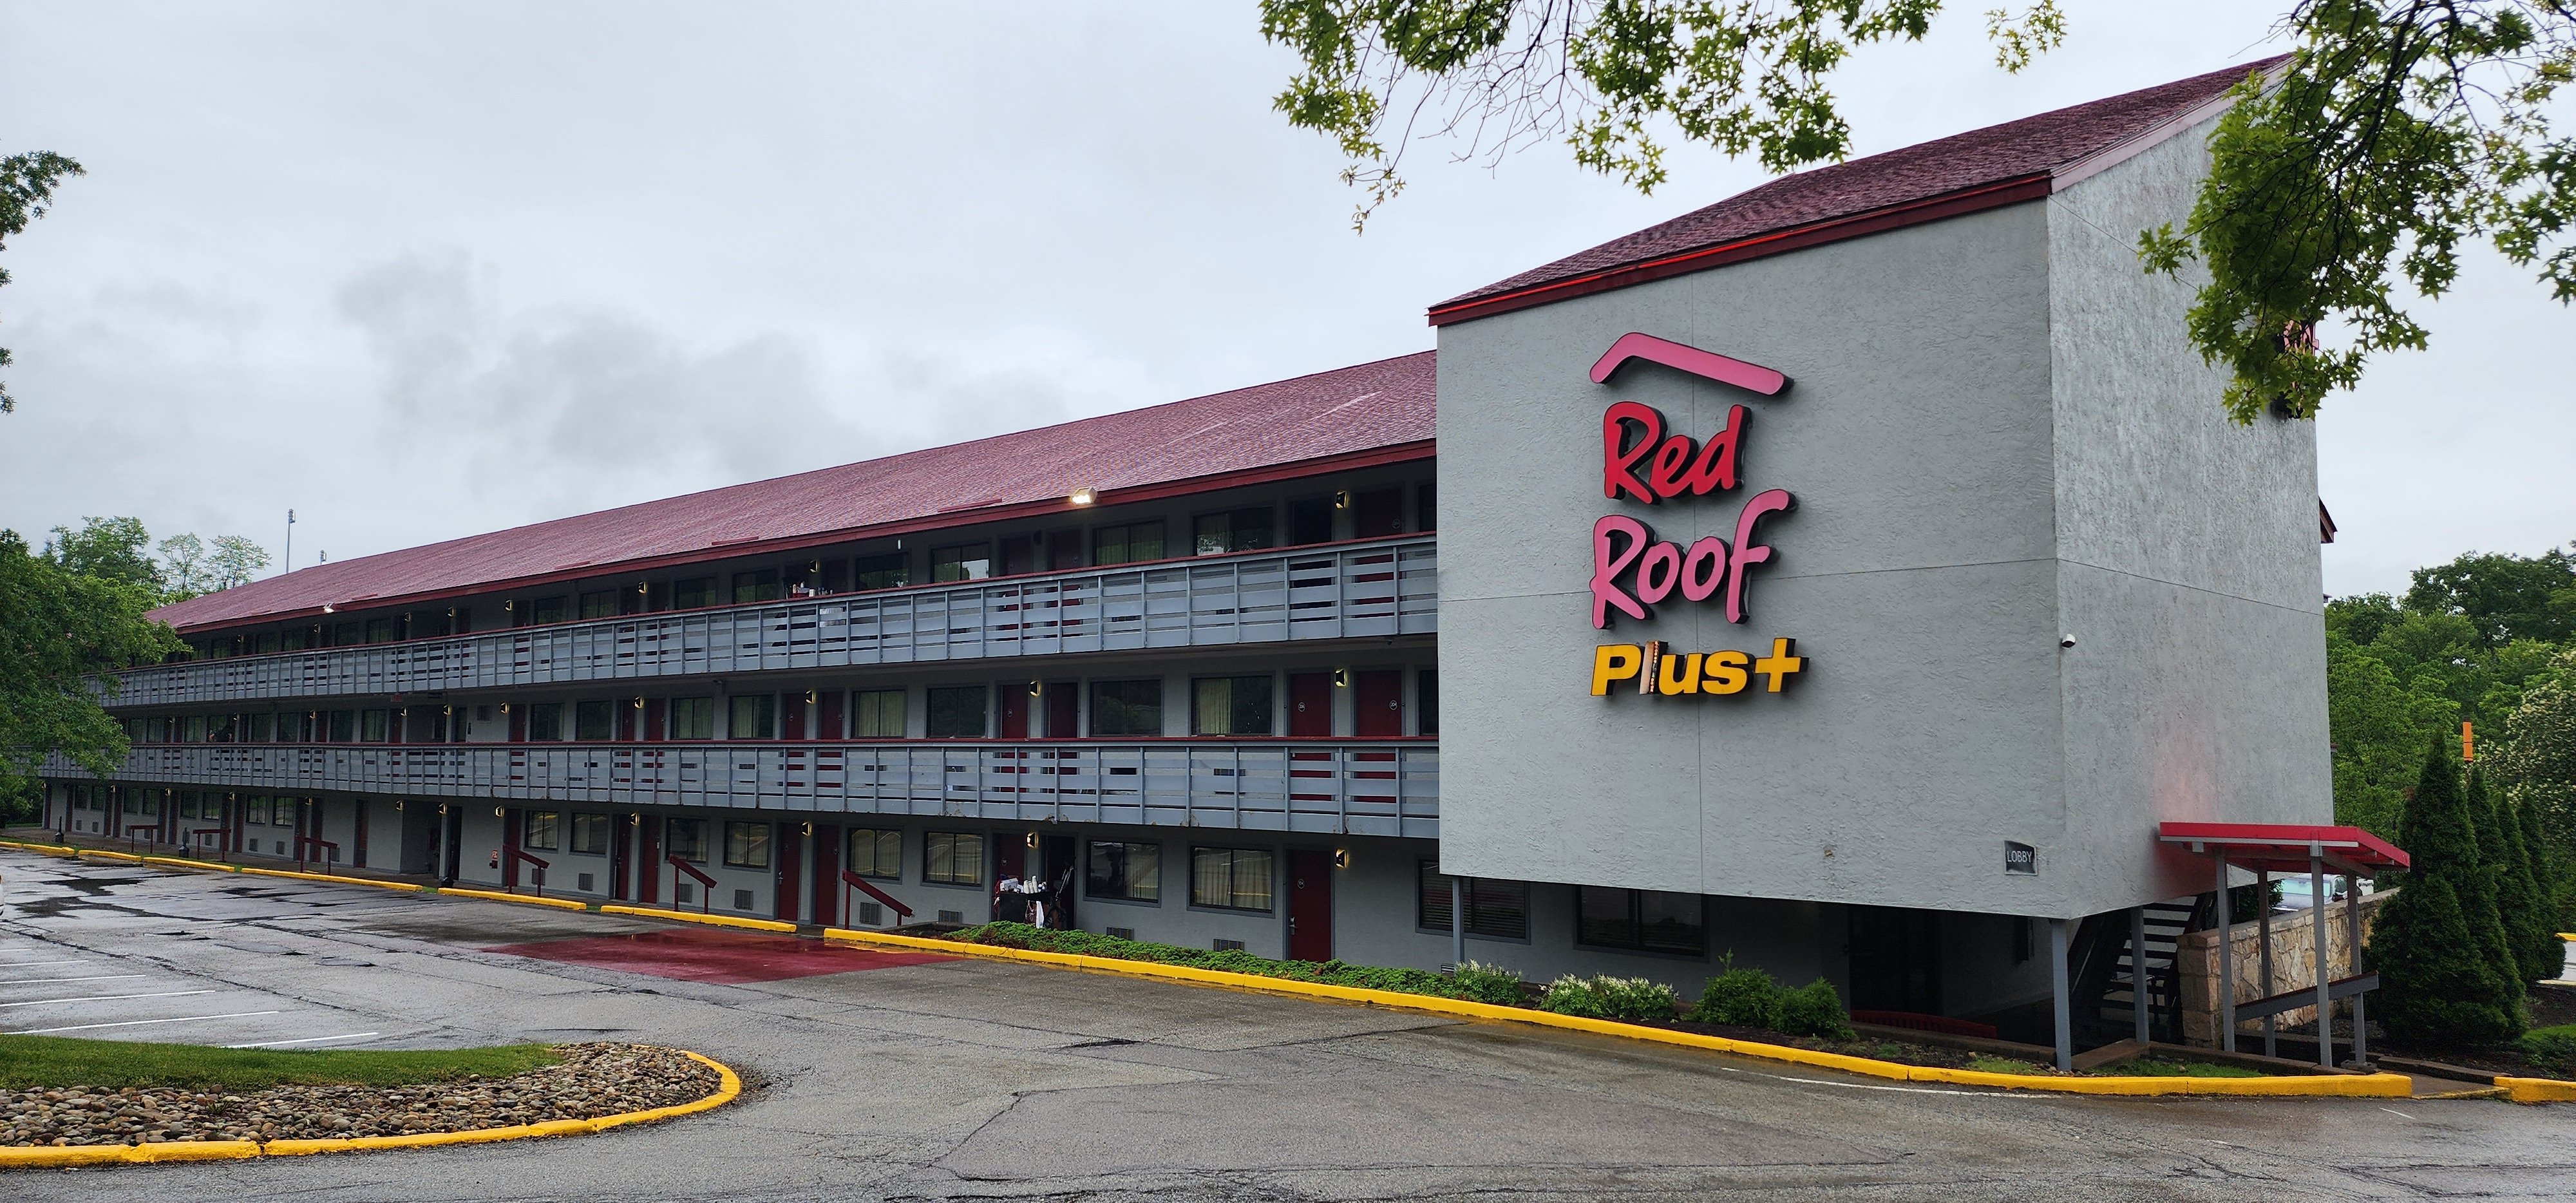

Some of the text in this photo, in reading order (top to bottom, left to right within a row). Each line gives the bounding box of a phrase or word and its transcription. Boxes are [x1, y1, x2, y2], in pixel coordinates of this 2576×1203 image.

[1604, 401, 1747, 504] Red
[1589, 488, 1793, 630] Roof
[1590, 637, 1804, 696] Plus+
[2006, 850, 2032, 863] LOBBY
